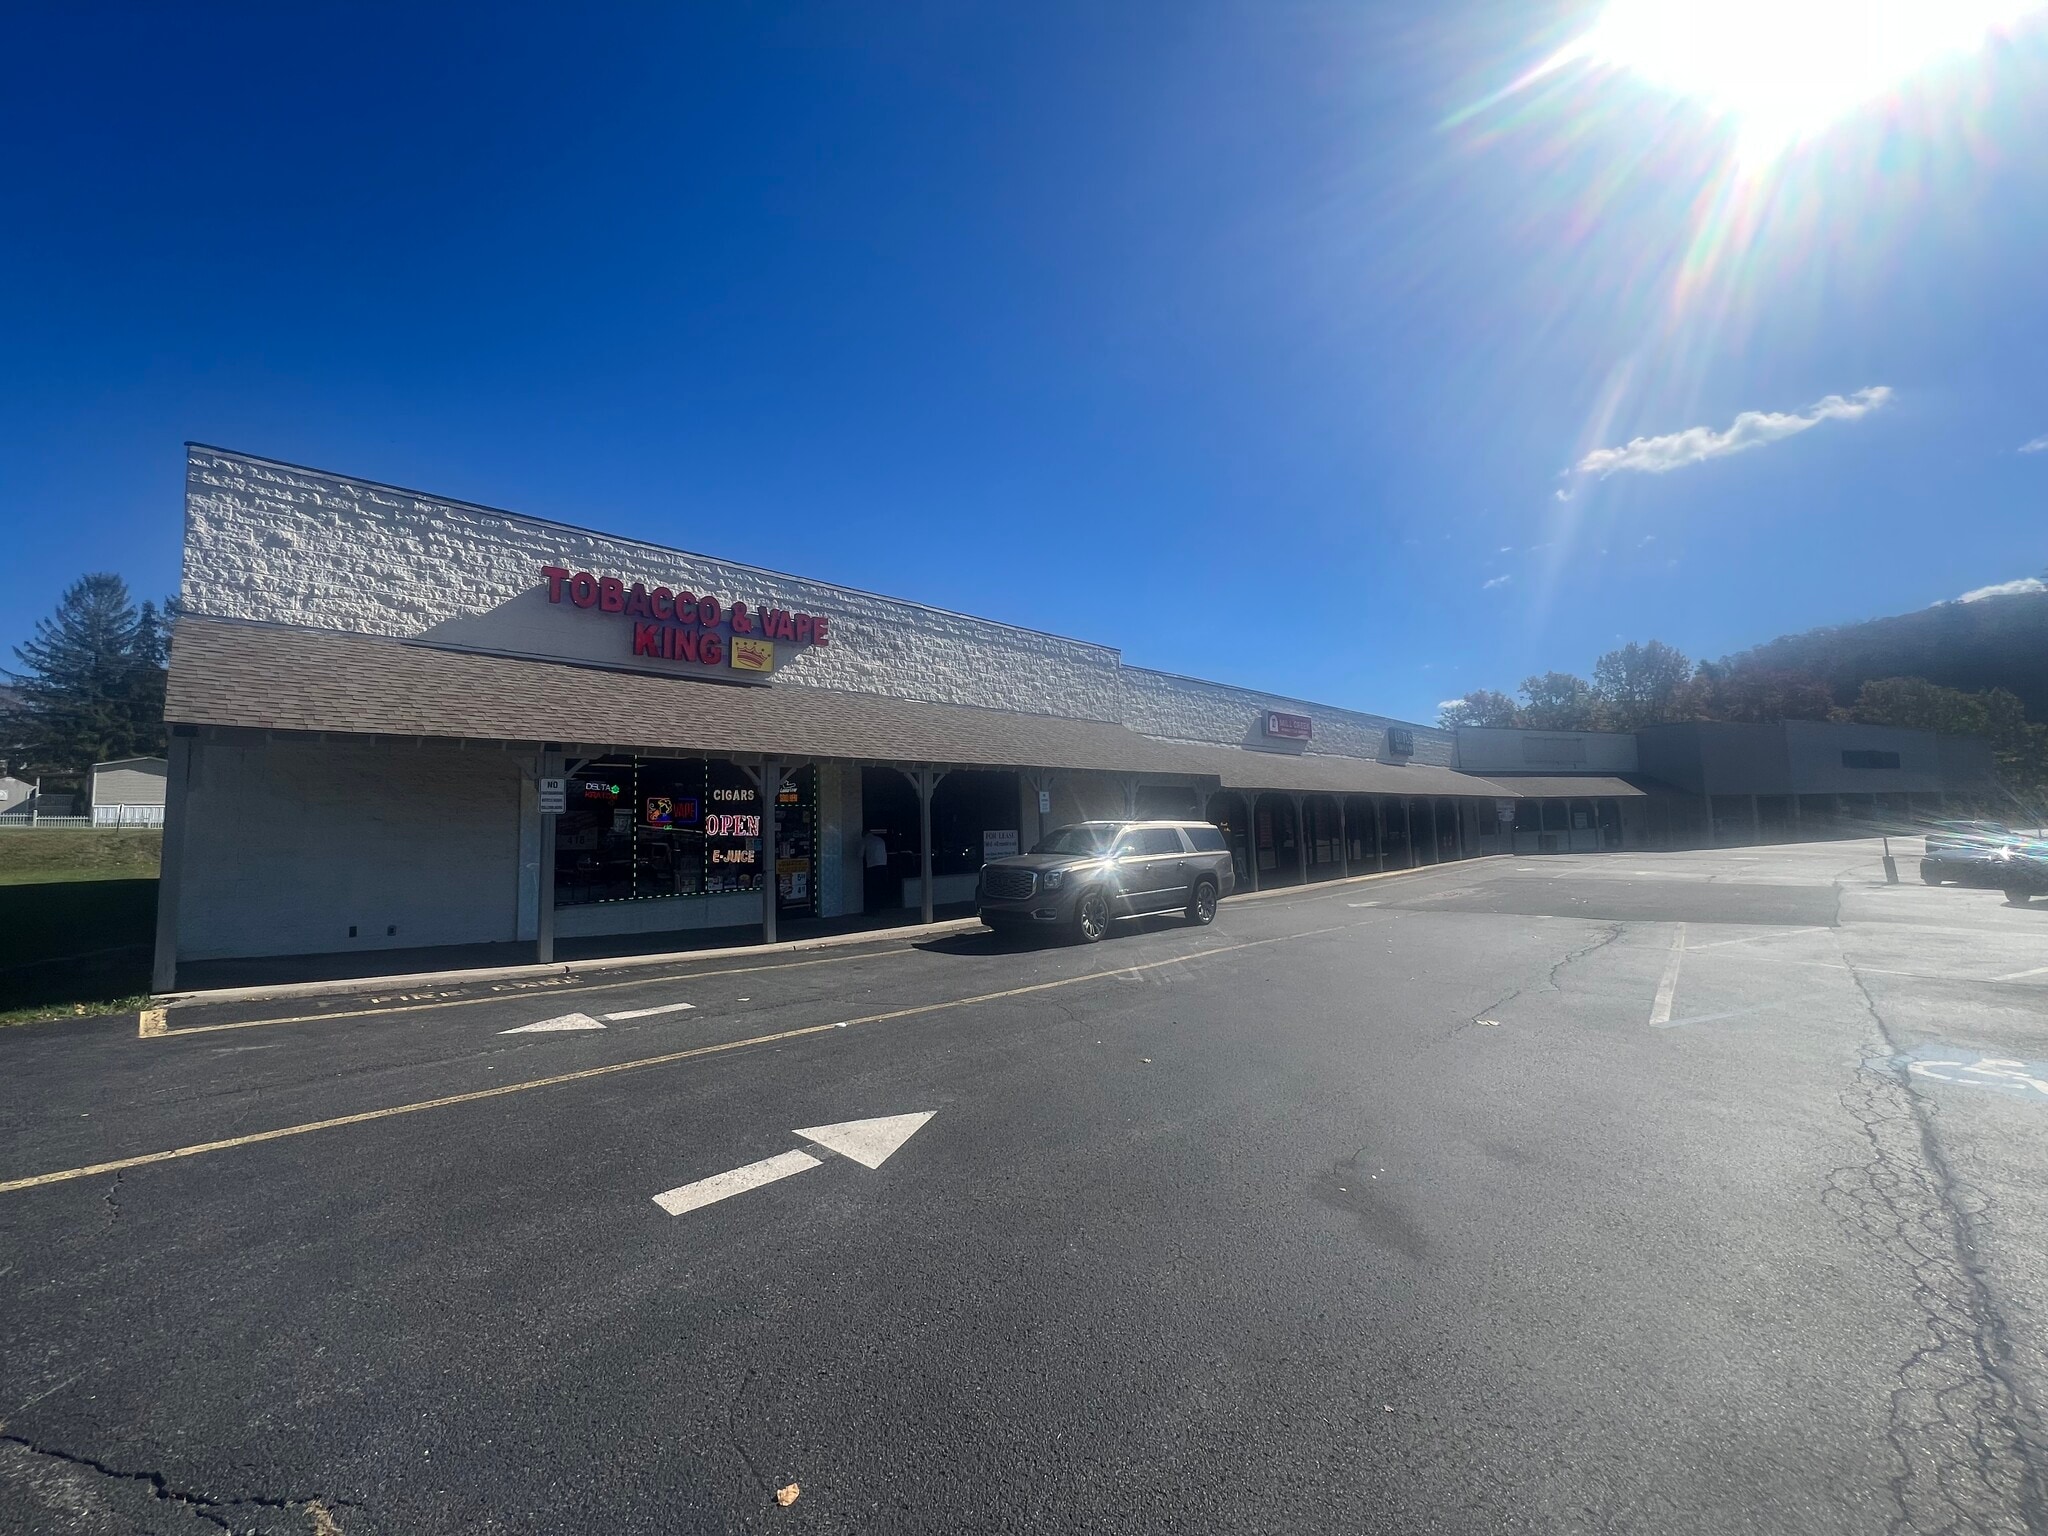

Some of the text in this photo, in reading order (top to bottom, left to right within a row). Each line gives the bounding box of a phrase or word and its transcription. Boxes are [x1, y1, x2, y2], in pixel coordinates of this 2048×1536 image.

[541, 566, 829, 646] TOBACCO & VAPE
[633, 622, 722, 665] KING
[547, 780, 558, 789] NO
[585, 782, 611, 792] DELTA
[713, 789, 755, 801] CIGARS
[706, 814, 761, 836] OPEN
[712, 849, 755, 863] E-JUICE
